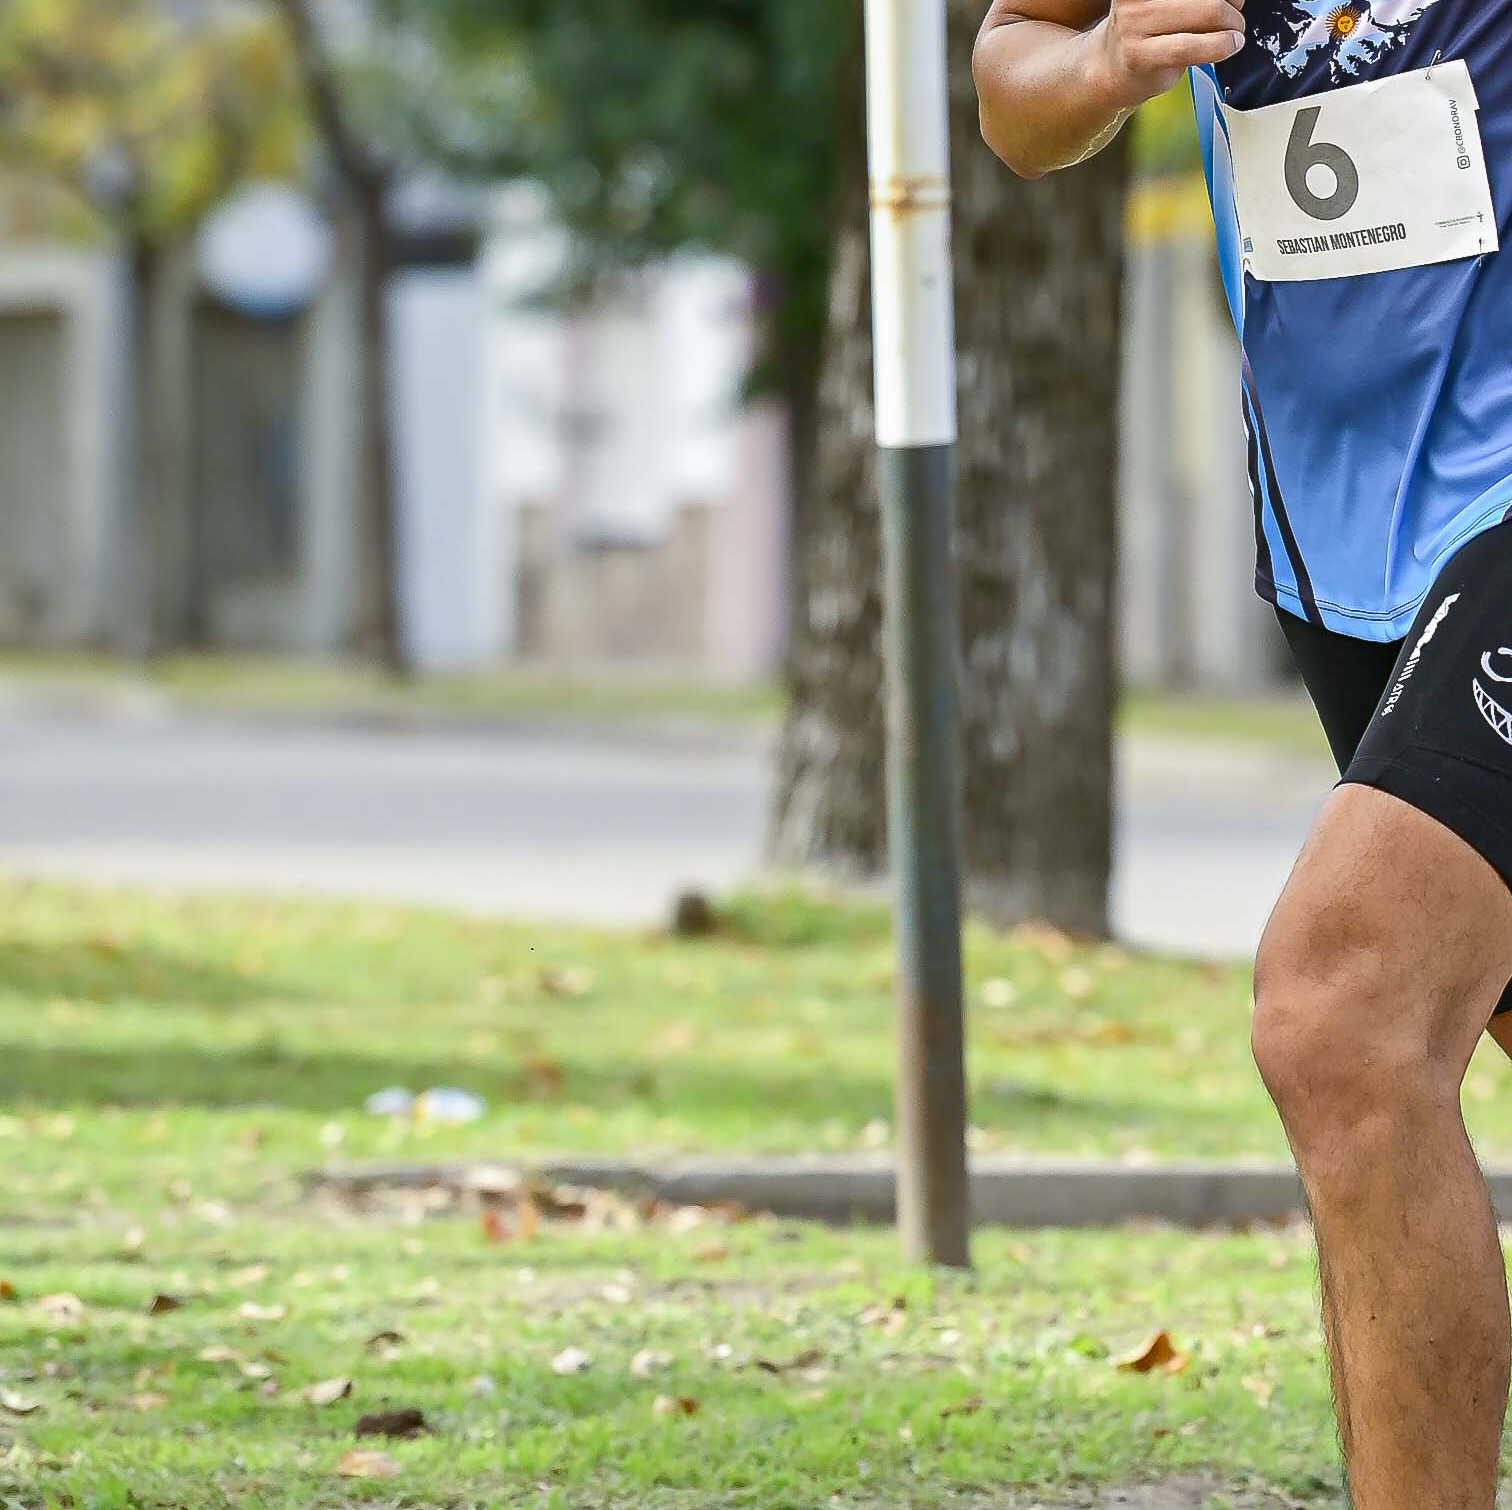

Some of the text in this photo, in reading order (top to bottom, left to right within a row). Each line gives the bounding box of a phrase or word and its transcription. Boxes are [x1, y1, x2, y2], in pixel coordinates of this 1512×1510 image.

[1284, 105, 1359, 221] 6
[1276, 223, 1407, 255] SEBASTIAN MONTENEGRO
